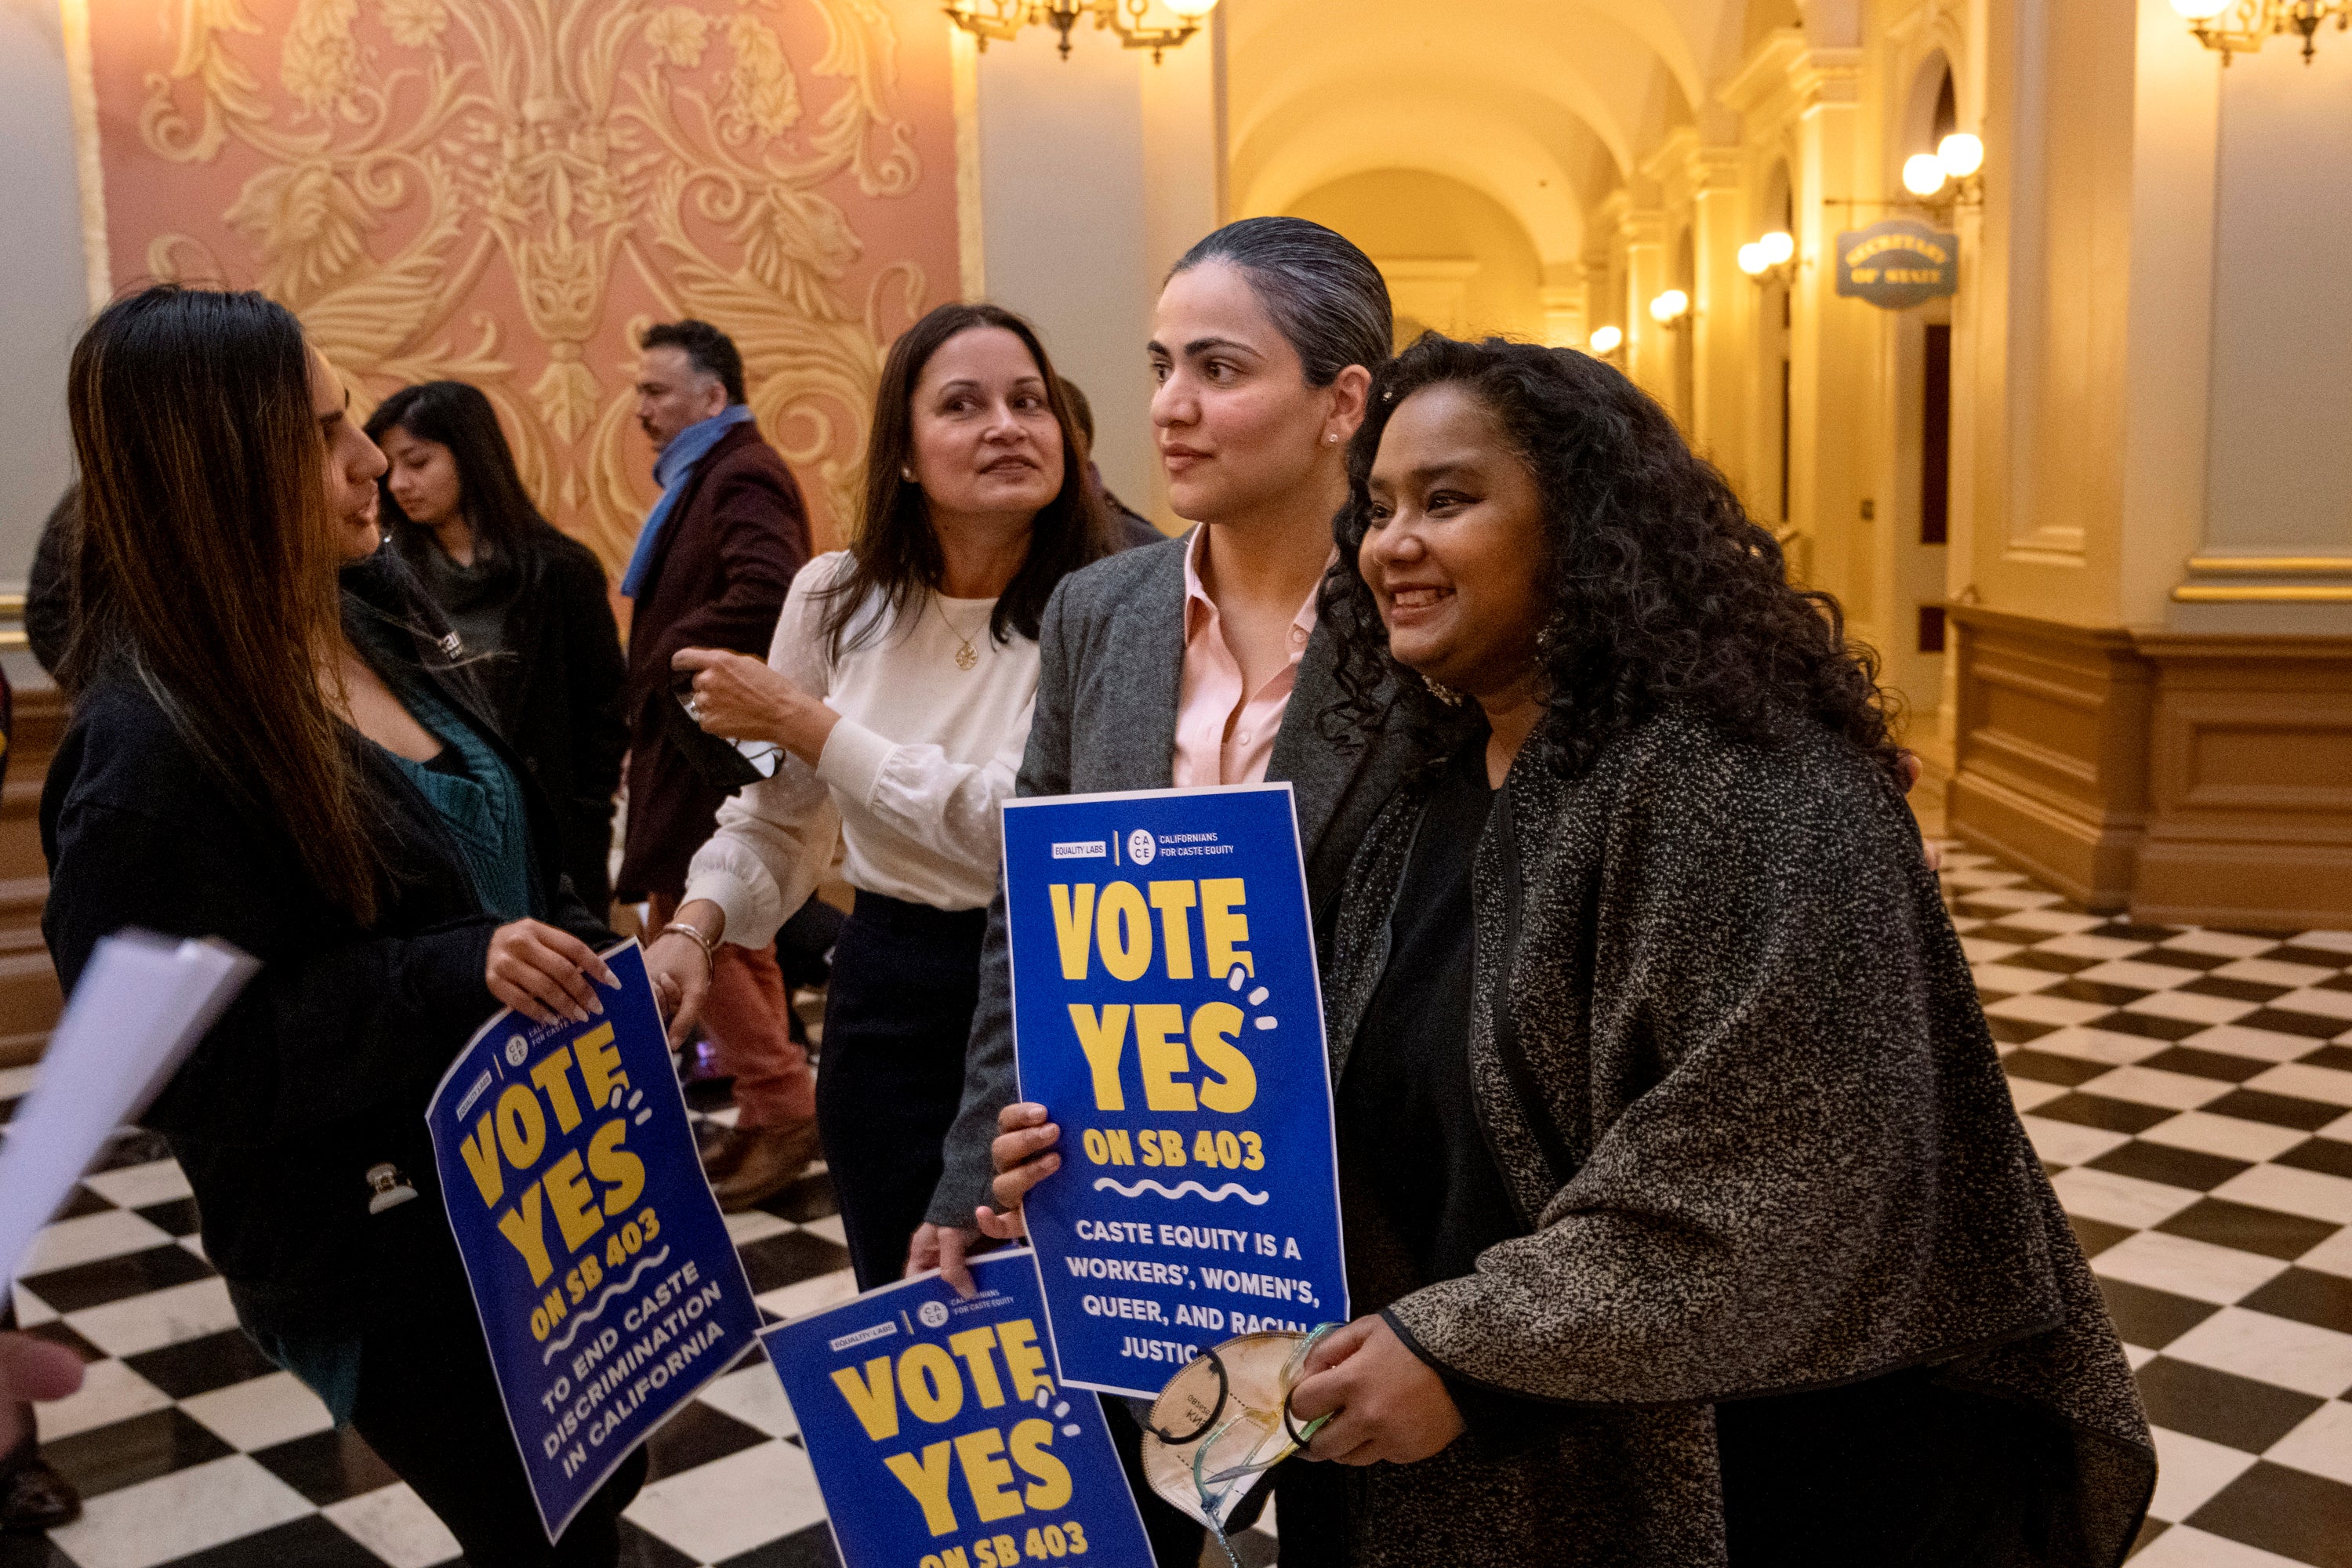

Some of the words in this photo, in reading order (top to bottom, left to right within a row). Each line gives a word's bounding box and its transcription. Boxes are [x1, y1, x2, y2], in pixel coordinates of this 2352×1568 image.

[1055, 846, 1084, 855] EQUALITY
[1086, 845, 1104, 854] LABS
[1160, 833, 1218, 844] CALIFORNIANS
[1161, 848, 1177, 857] FOR
[1178, 847, 1203, 856] CASTE
[1205, 845, 1234, 855] EQUITY
[1049, 877, 1254, 981] VOTE
[1068, 1001, 1257, 1113] YES
[459, 1088, 477, 1118] EQUALITY
[477, 1076, 491, 1091] LABS
[459, 1022, 630, 1209] VOTE
[1083, 1129, 1135, 1166] ON
[1138, 1130, 1187, 1167] SB
[1194, 1131, 1265, 1171] 403
[497, 1119, 645, 1288] YES
[1076, 1220, 1153, 1243] CASTE
[1160, 1225, 1247, 1252] EQUITY
[1255, 1232, 1277, 1256] IS
[1284, 1238, 1301, 1260] A
[531, 1287, 568, 1341] ON
[566, 1254, 603, 1305] SB
[606, 1208, 660, 1268] 403
[1201, 1268, 1320, 1308] WOMEN'S,
[951, 1290, 1000, 1305] CALNIANS
[954, 1306, 968, 1315] FOR
[970, 1301, 991, 1311] CASTE
[992, 1297, 1014, 1307] EQUITY
[1083, 1294, 1168, 1326] QUEER,
[1176, 1305, 1224, 1330] AND
[542, 1377, 571, 1414] TO
[572, 1328, 619, 1381] END
[624, 1261, 700, 1332] CASTE
[835, 1332, 871, 1348] EQUALITY
[873, 1325, 893, 1337] LABS
[1121, 1337, 1199, 1363] JUSTIC
[543, 1281, 722, 1461] DISCRIMINATION
[830, 1318, 1055, 1441] VOTE
[563, 1442, 587, 1479] IN
[589, 1321, 724, 1446] CALIFORNIA
[884, 1418, 1072, 1537] YES
[974, 1534, 1020, 1568] SB
[1025, 1521, 1088, 1560] 403
